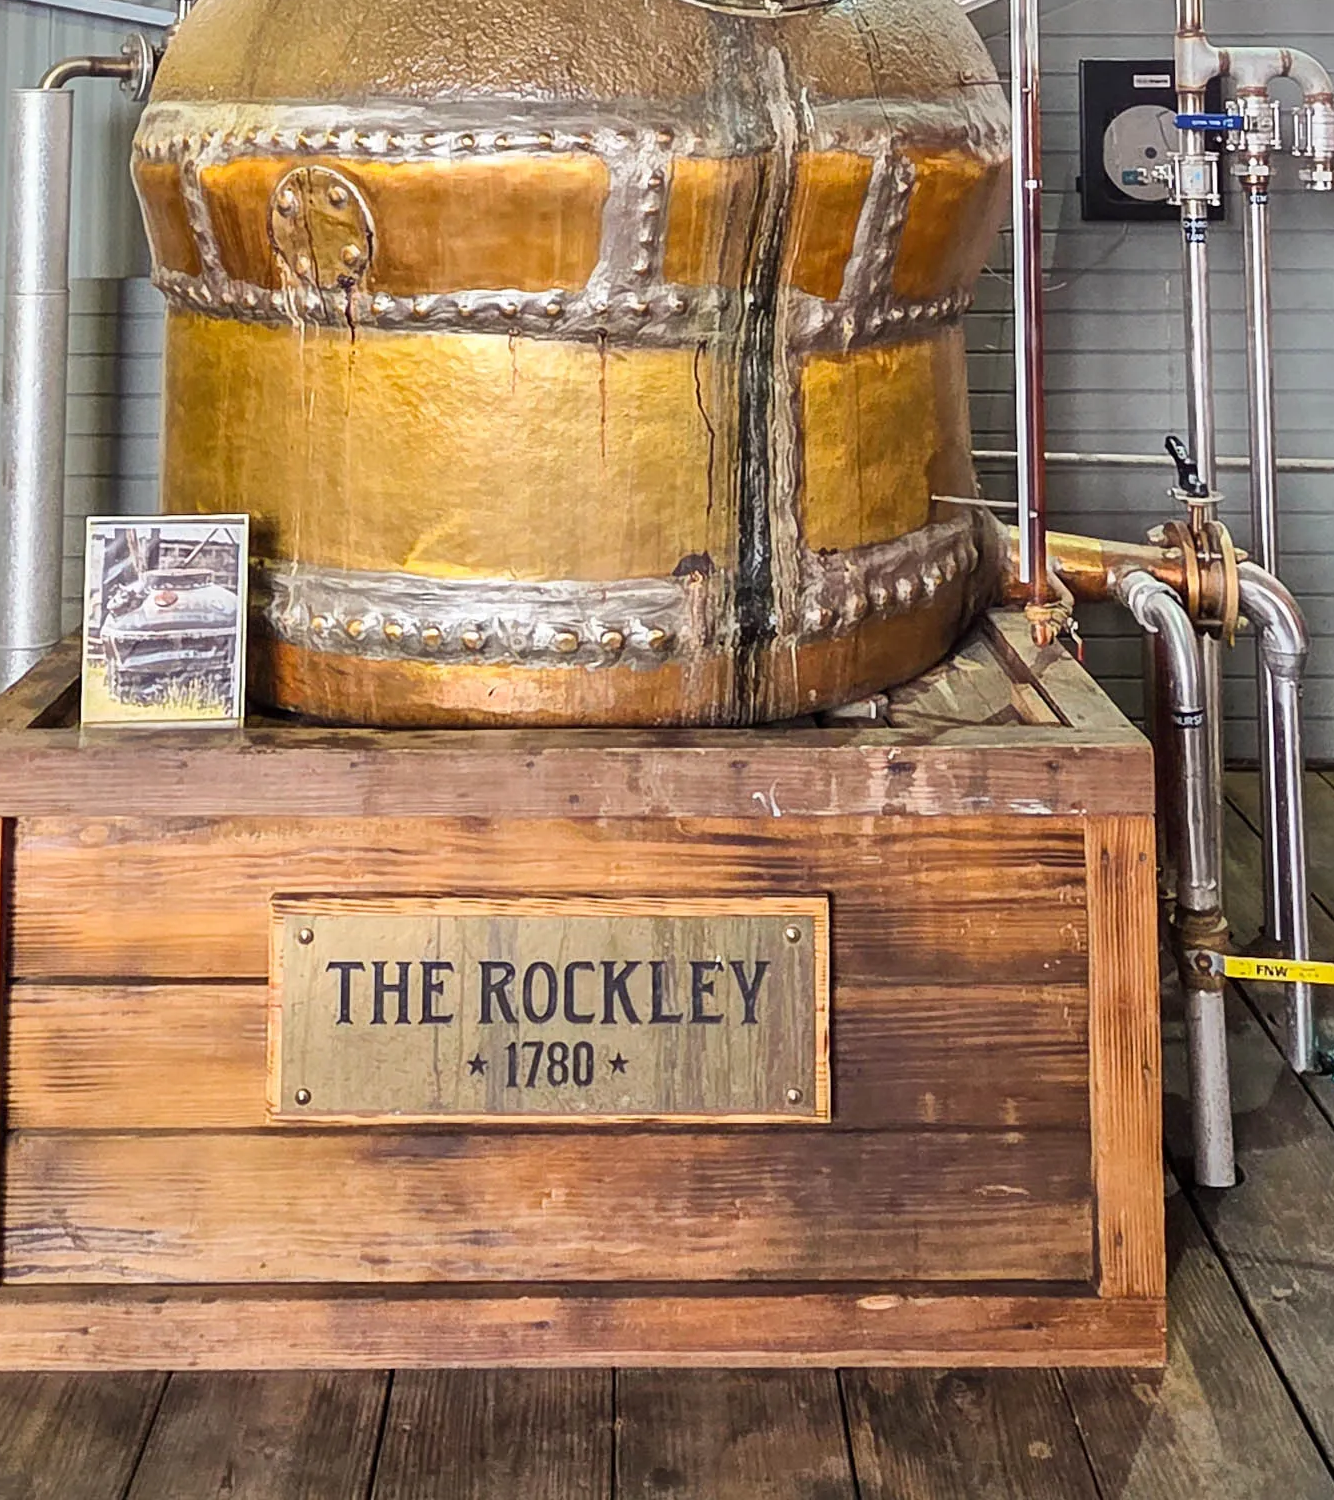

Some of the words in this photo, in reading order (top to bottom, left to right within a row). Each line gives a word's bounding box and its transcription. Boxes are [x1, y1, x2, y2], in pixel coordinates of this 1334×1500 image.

[325, 960, 454, 1025] THE
[477, 960, 771, 1025] ROCKLEY
[1255, 964, 1287, 977] FNW
[505, 1040, 595, 1088] 1780
